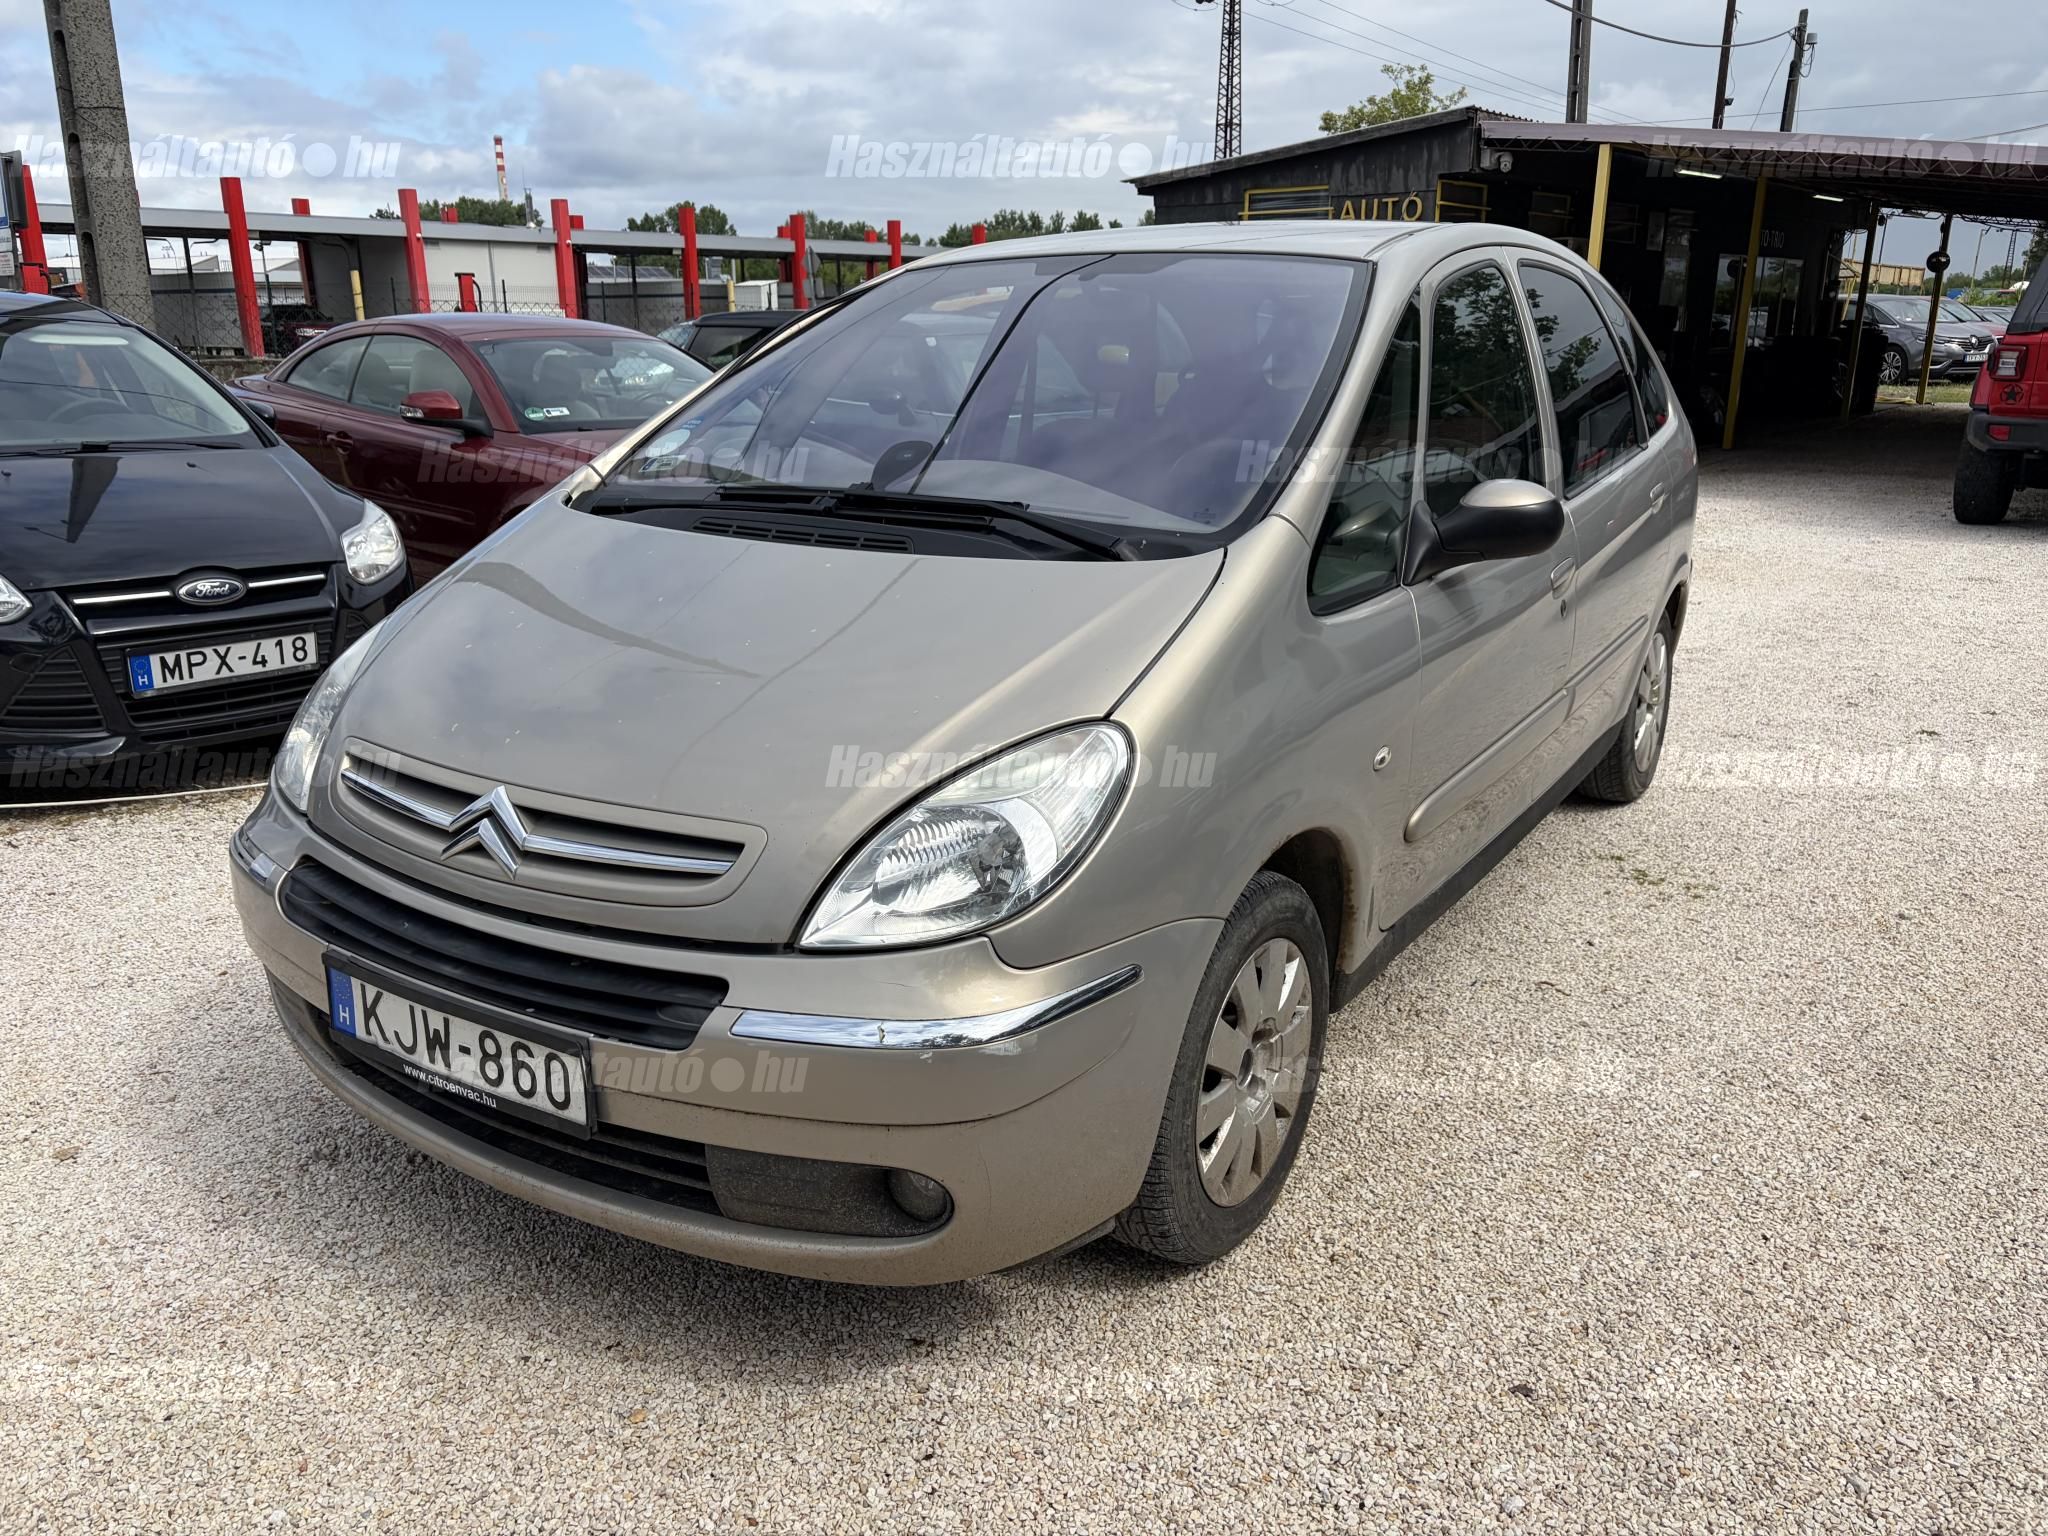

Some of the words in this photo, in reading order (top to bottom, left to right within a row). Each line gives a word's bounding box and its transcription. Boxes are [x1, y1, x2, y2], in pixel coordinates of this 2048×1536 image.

[1340, 190, 1423, 221] AUTÓ
[195, 581, 230, 597] Ford
[138, 674, 149, 687] H
[159, 636, 308, 683] MPX-418
[338, 1004, 350, 1026] H
[361, 983, 571, 1111] KJW-860
[403, 1063, 497, 1108] www.citroenvac.hu
